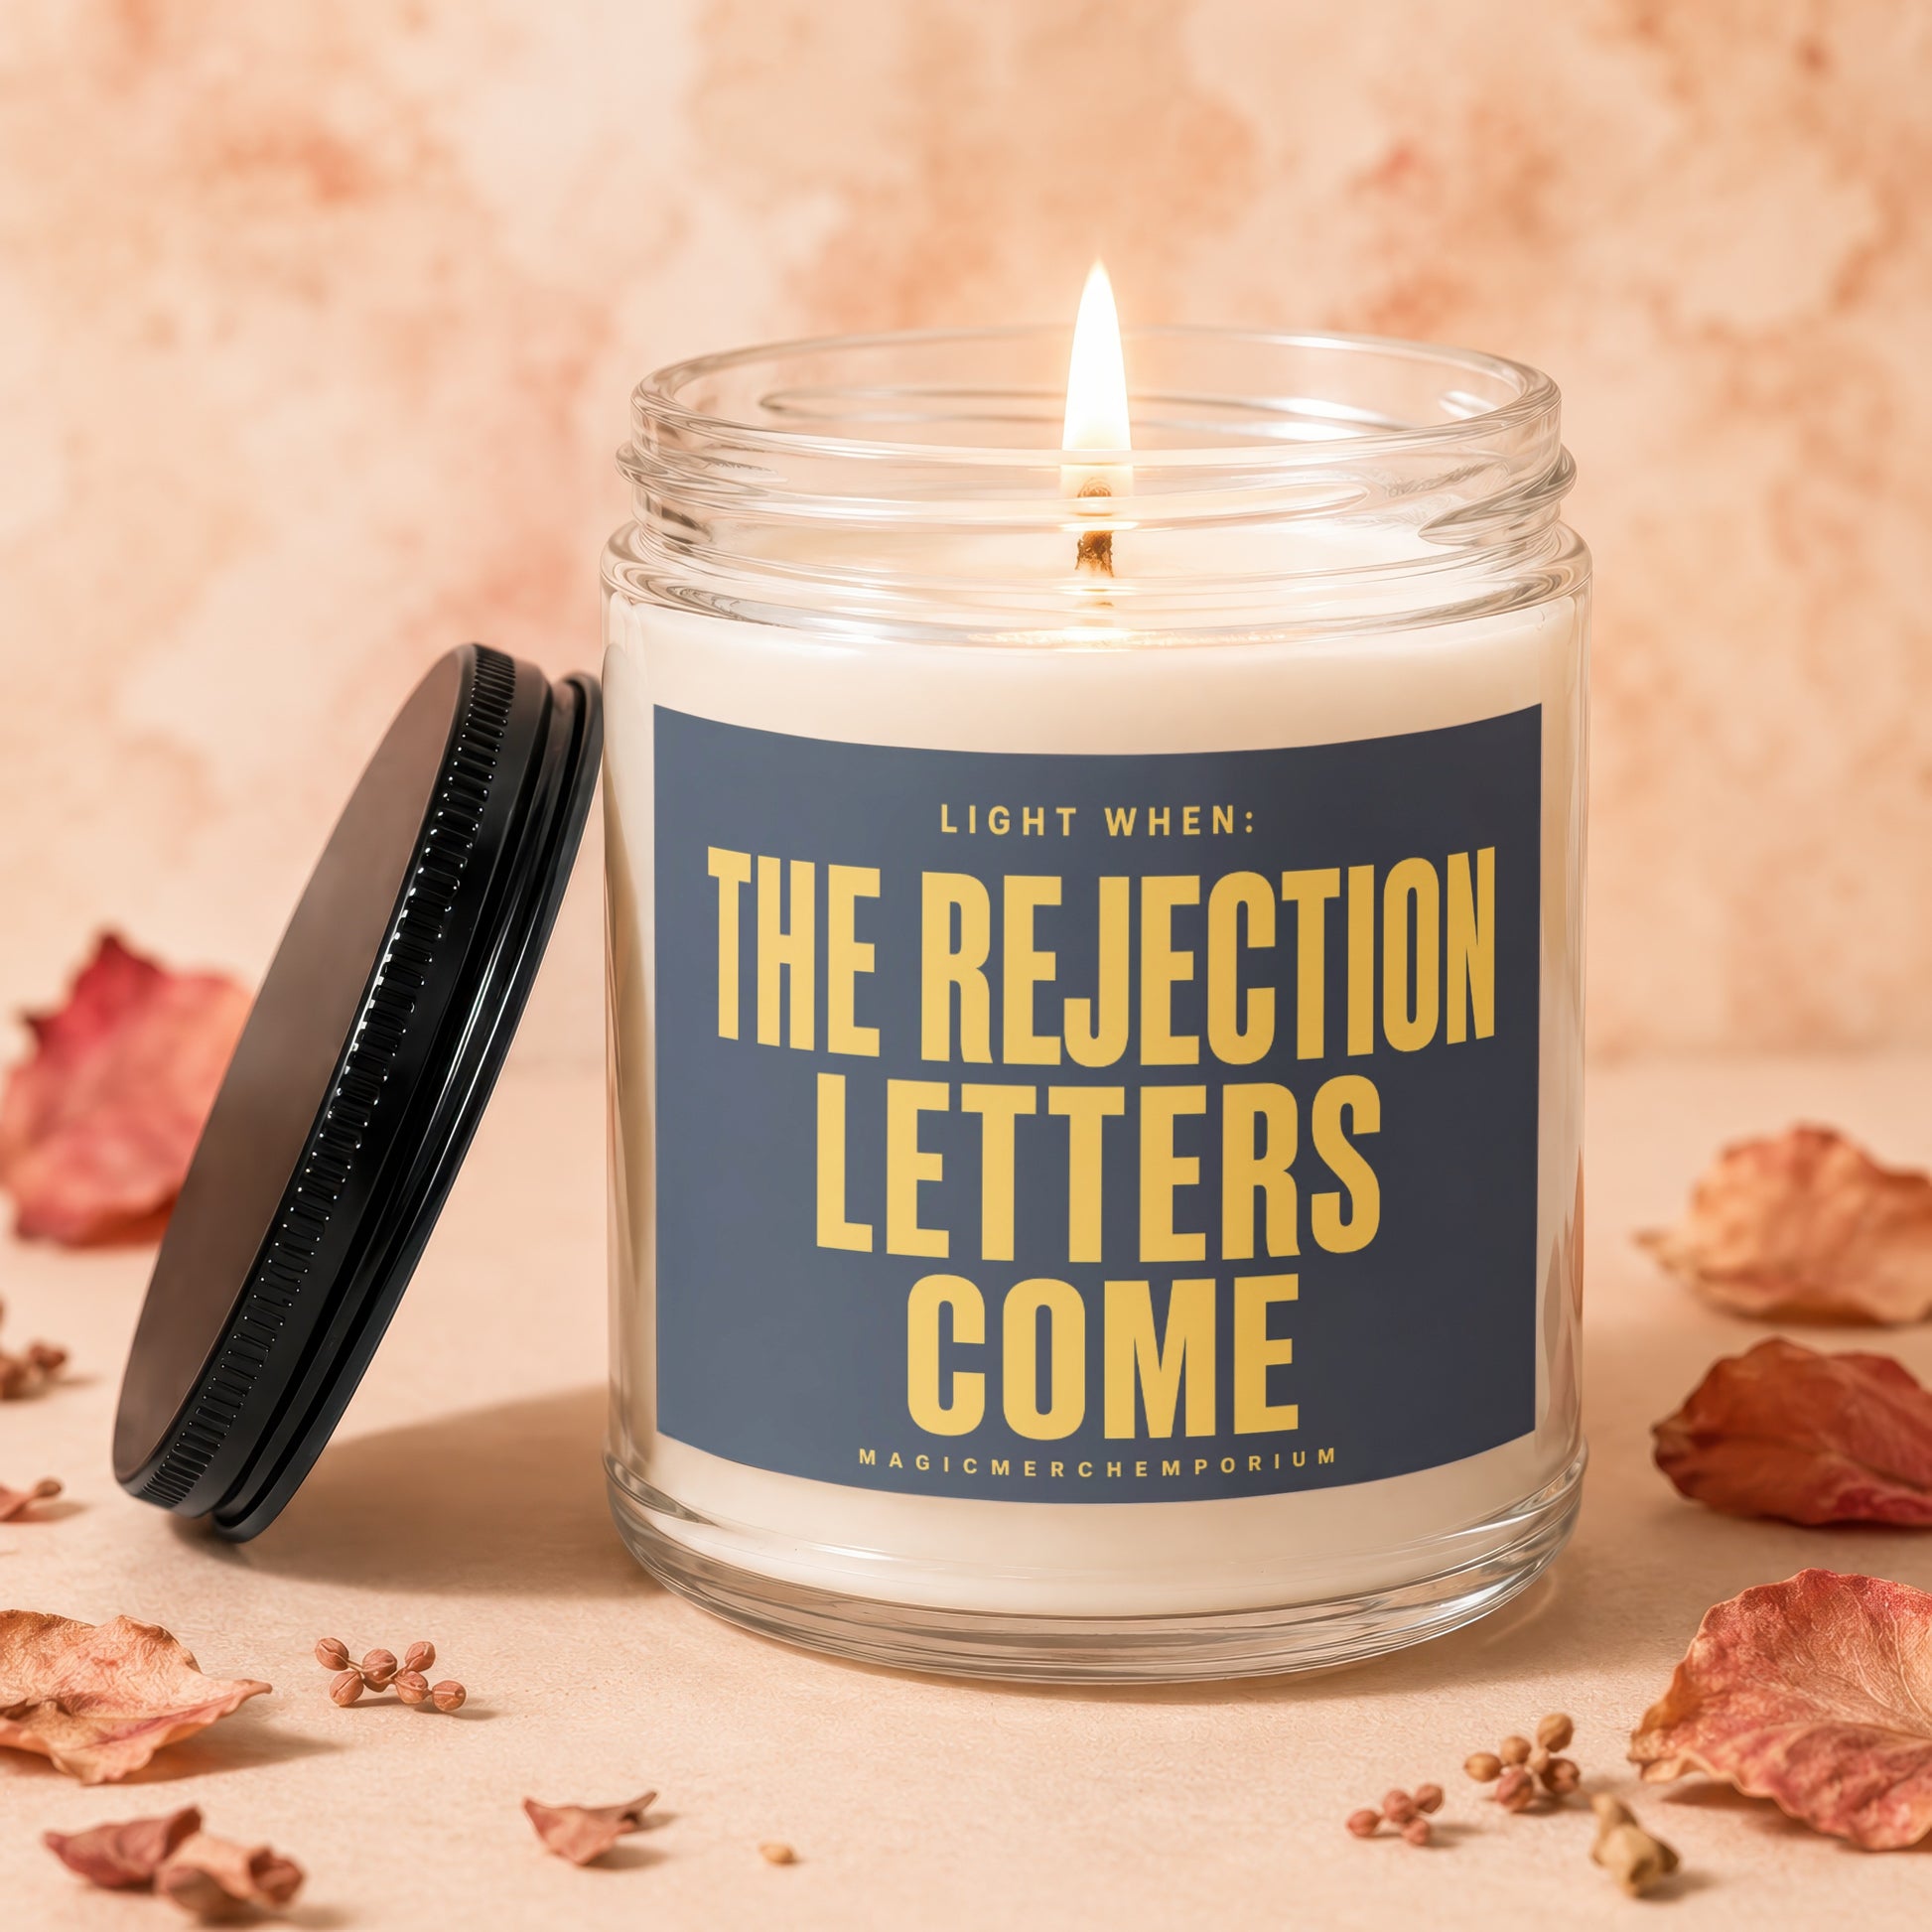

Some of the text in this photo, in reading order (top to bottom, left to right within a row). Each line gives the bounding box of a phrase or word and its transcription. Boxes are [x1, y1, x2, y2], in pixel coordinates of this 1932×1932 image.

[940, 802, 1254, 838] LIGHT WHEN:
[707, 844, 1497, 1069] THE REJECTION
[815, 1071, 1382, 1264] LETTERS
[906, 1273, 1301, 1442] COME
[857, 1446, 1337, 1478] MAGICMERCHEMPORIUM
